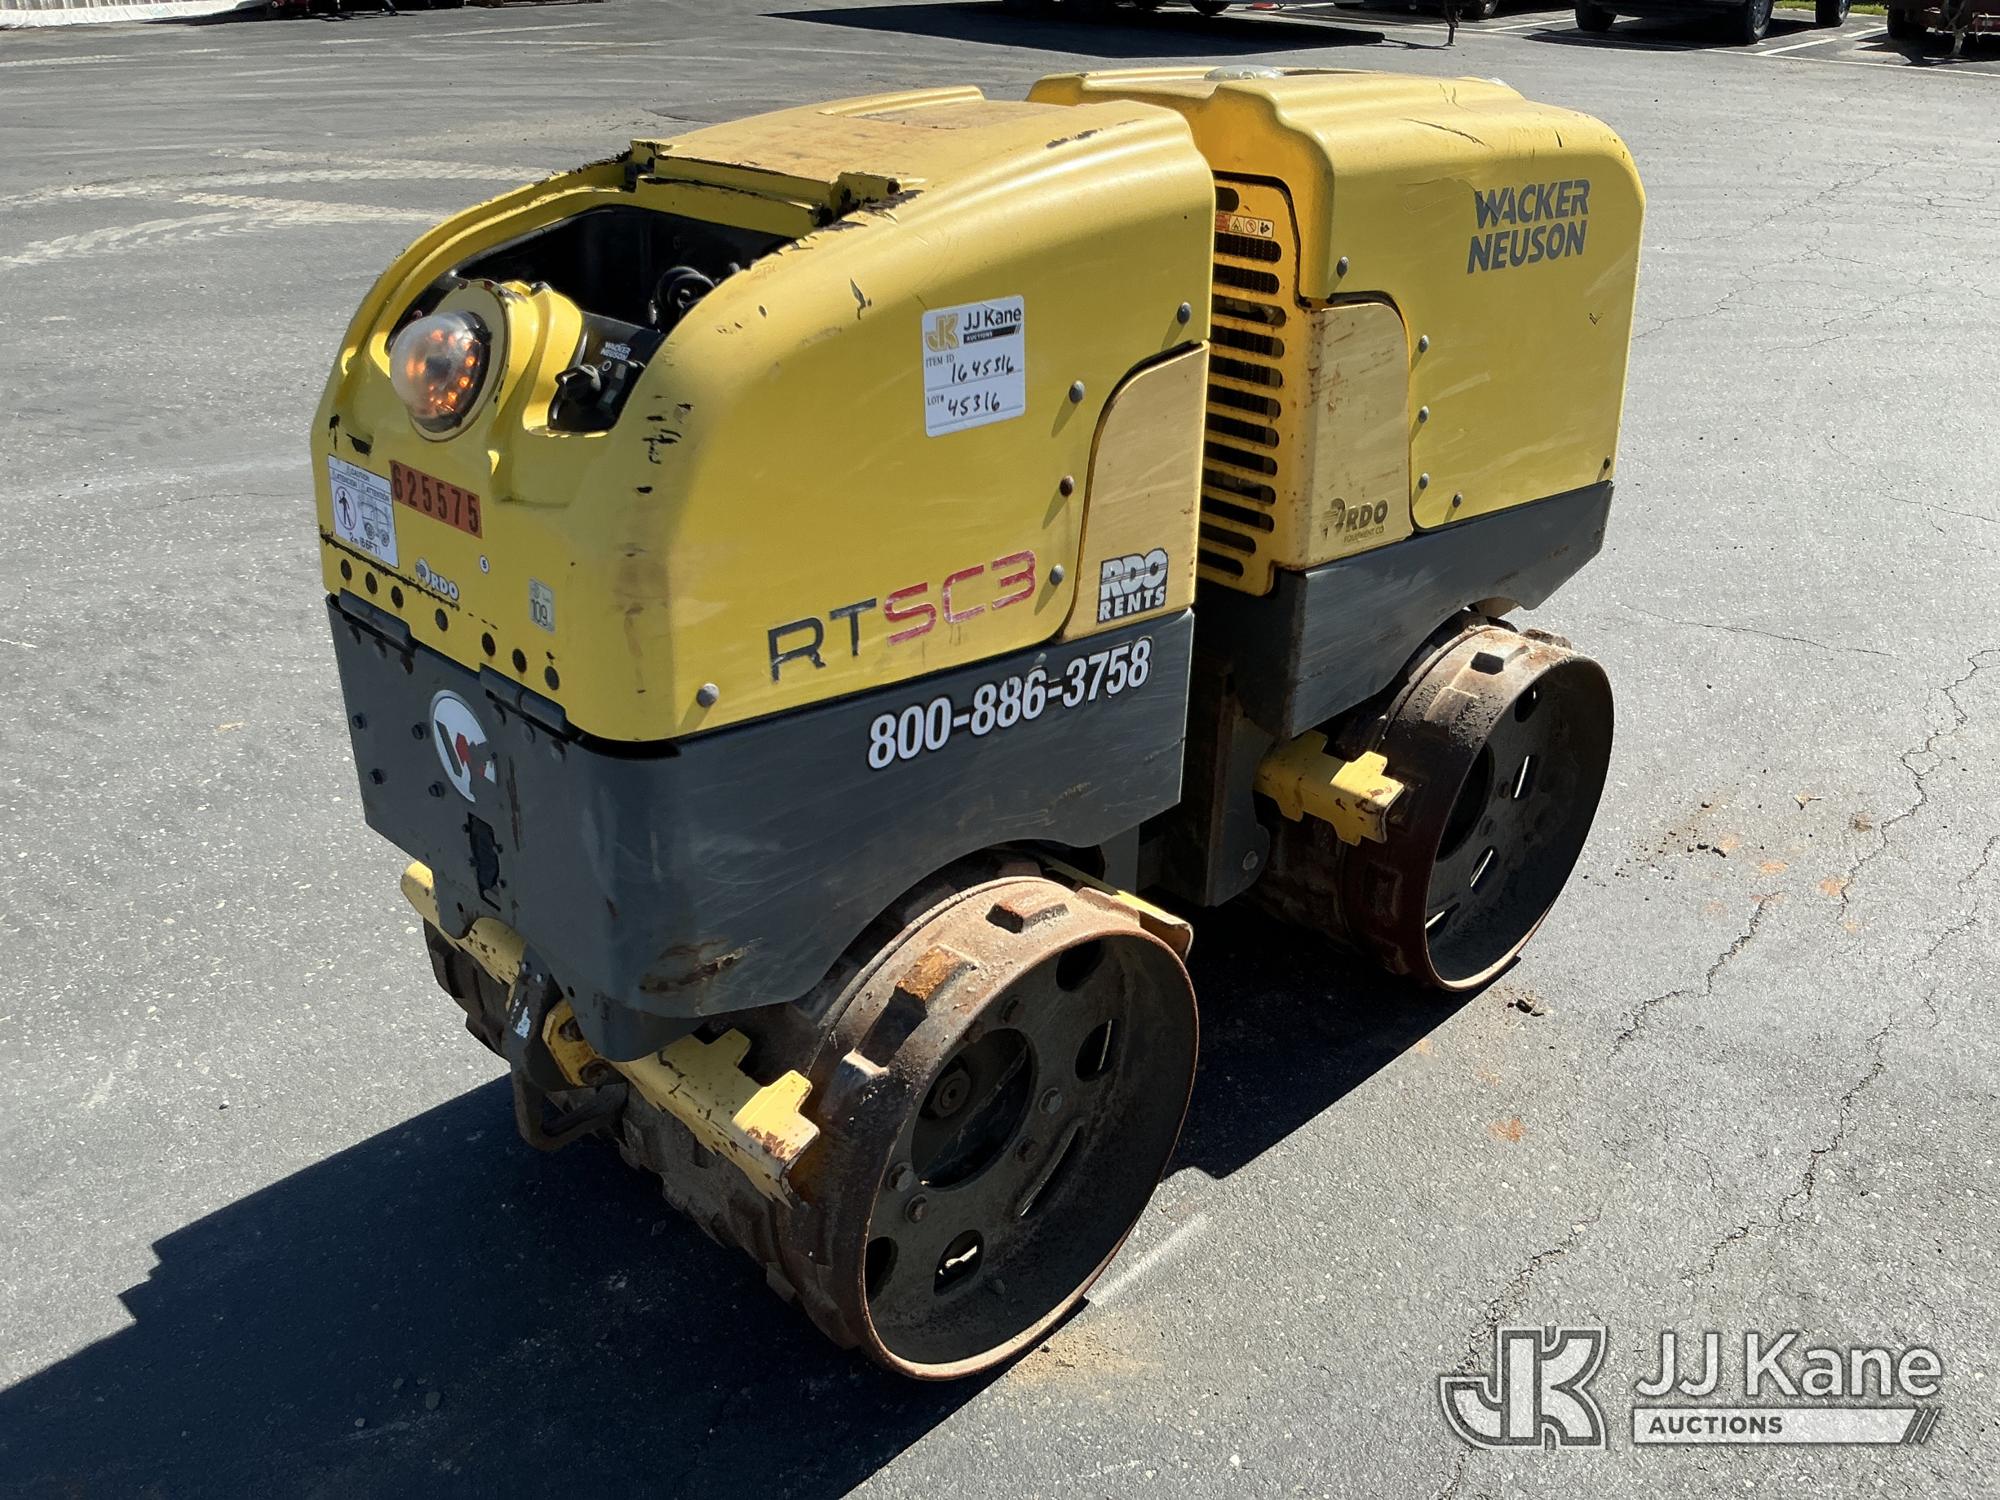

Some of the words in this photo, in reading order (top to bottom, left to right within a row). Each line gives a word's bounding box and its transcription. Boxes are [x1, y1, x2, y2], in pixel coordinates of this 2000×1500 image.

[1475, 179, 1590, 228] WACKER
[1467, 220, 1587, 274] NEUSON
[964, 312, 981, 331] JJ
[985, 308, 1022, 327] Kane
[606, 341, 631, 354] WACKER
[966, 332, 993, 341] AUCTIONS
[926, 356, 944, 368] ITEM
[946, 354, 955, 363] ID
[948, 391, 1000, 417] 45316
[392, 463, 479, 533] 625575
[1345, 499, 1388, 532] RDO
[431, 571, 459, 601] RDO
[1101, 548, 1168, 599] RDO
[768, 550, 1035, 683] RTSC3
[1099, 587, 1165, 621] RENTS
[869, 637, 1152, 770] 800-886-3758
